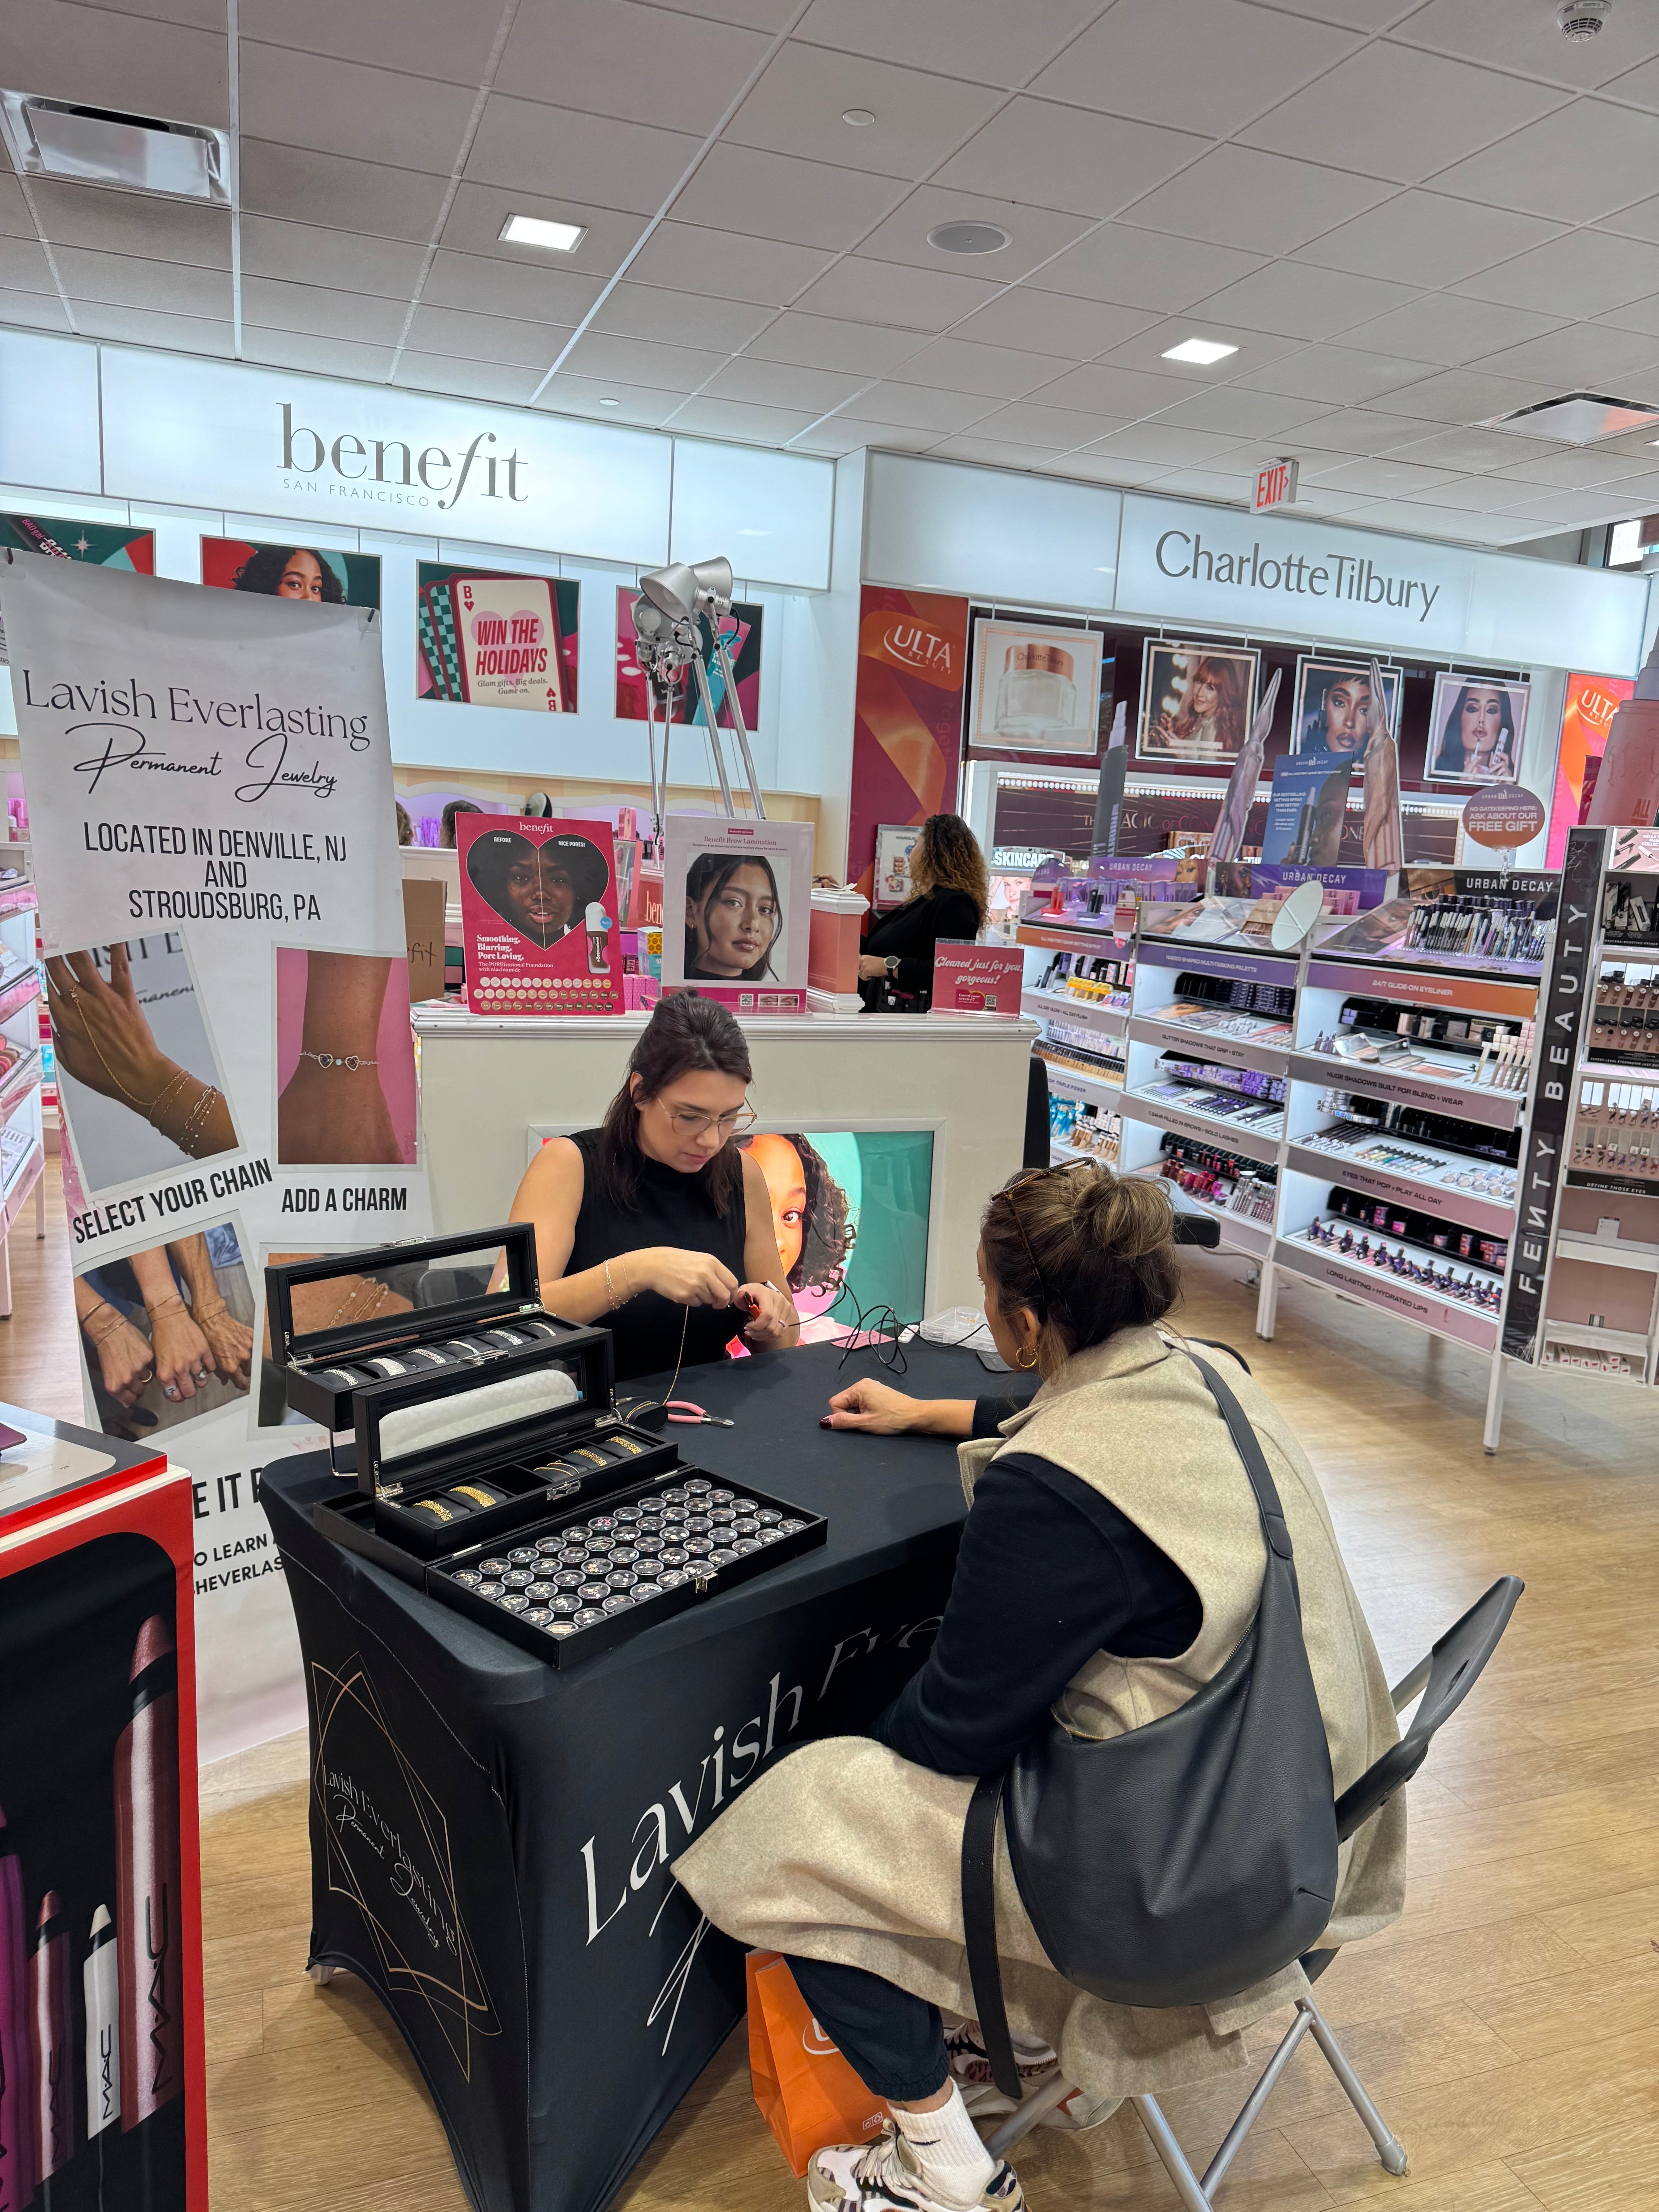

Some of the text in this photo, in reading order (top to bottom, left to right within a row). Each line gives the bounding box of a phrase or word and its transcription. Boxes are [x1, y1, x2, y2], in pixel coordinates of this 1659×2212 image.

[276, 402, 528, 509] benefit
[283, 479, 429, 507] SAN FRANCISCO
[1256, 465, 1286, 508] EXIT
[463, 586, 472, 599] B
[477, 618, 539, 646] WIN THE
[894, 625, 950, 668] ULTA
[476, 648, 548, 676] HOLIDAYS
[908, 651, 951, 675] BEAUTY
[497, 679, 514, 688] gifts.
[22, 669, 370, 752] Lavish Everlasting
[1589, 711, 1608, 727] BEAU
[65, 723, 337, 803] Permanent Jewelry
[519, 821, 554, 835] benefit
[1469, 821, 1537, 832] FREE GIFT
[83, 821, 346, 864] LOCATED IN DENVILLE, NJ
[204, 860, 247, 888] AND
[1132, 863, 1153, 871] DECAY
[1283, 872, 1347, 884] URBAN DECAY
[1466, 878, 1554, 893] URBAN DECAY
[129, 890, 321, 922] STROUDSBURG, PA
[477, 934, 521, 944] Smoothing.
[477, 943, 512, 953] Blurring.
[478, 951, 524, 962] Pore Loving.
[934, 956, 1023, 974] Cleaned just for you,
[1201, 959, 1235, 970] MULTI-TASKING
[1235, 965, 1257, 973] PALETTE
[955, 975, 1001, 986] gorgeous!
[1388, 982, 1419, 991] GLIDE-ON
[1419, 986, 1453, 996] EYELINER
[1544, 904, 1587, 1101] BEAUTY
[1162, 1034, 1180, 1043] GLITTER
[1180, 1038, 1203, 1049] SHADOWS
[1204, 1043, 1216, 1051] THAT
[1056, 1080, 1070, 1089] TRIPLE
[1070, 1085, 1086, 1093] POWER
[1326, 1072, 1463, 1107] NUDE SHADOWS BUILT FOR BLEND WEAR
[1183, 1122, 1202, 1131] BROWS
[1219, 1133, 1239, 1143] LASHES
[73, 1158, 273, 1244] SELECT YOUR CHAIN
[282, 1187, 407, 1213] ADD A CHARM
[1342, 1170, 1442, 1206] EYES THAT POP PLAY ALL DAY
[1326, 1268, 1428, 1314] LONG LASTING HYDRATED LIPS
[217, 1472, 241, 1512] IT
[213, 1533, 268, 1562] LEARN
[194, 1556, 283, 1595] HEVERLAS
[580, 1671, 803, 1946] Lavish
[323, 1764, 457, 1956] Lavish Everlasting
[333, 1794, 441, 1949] Permanent Jewelry
